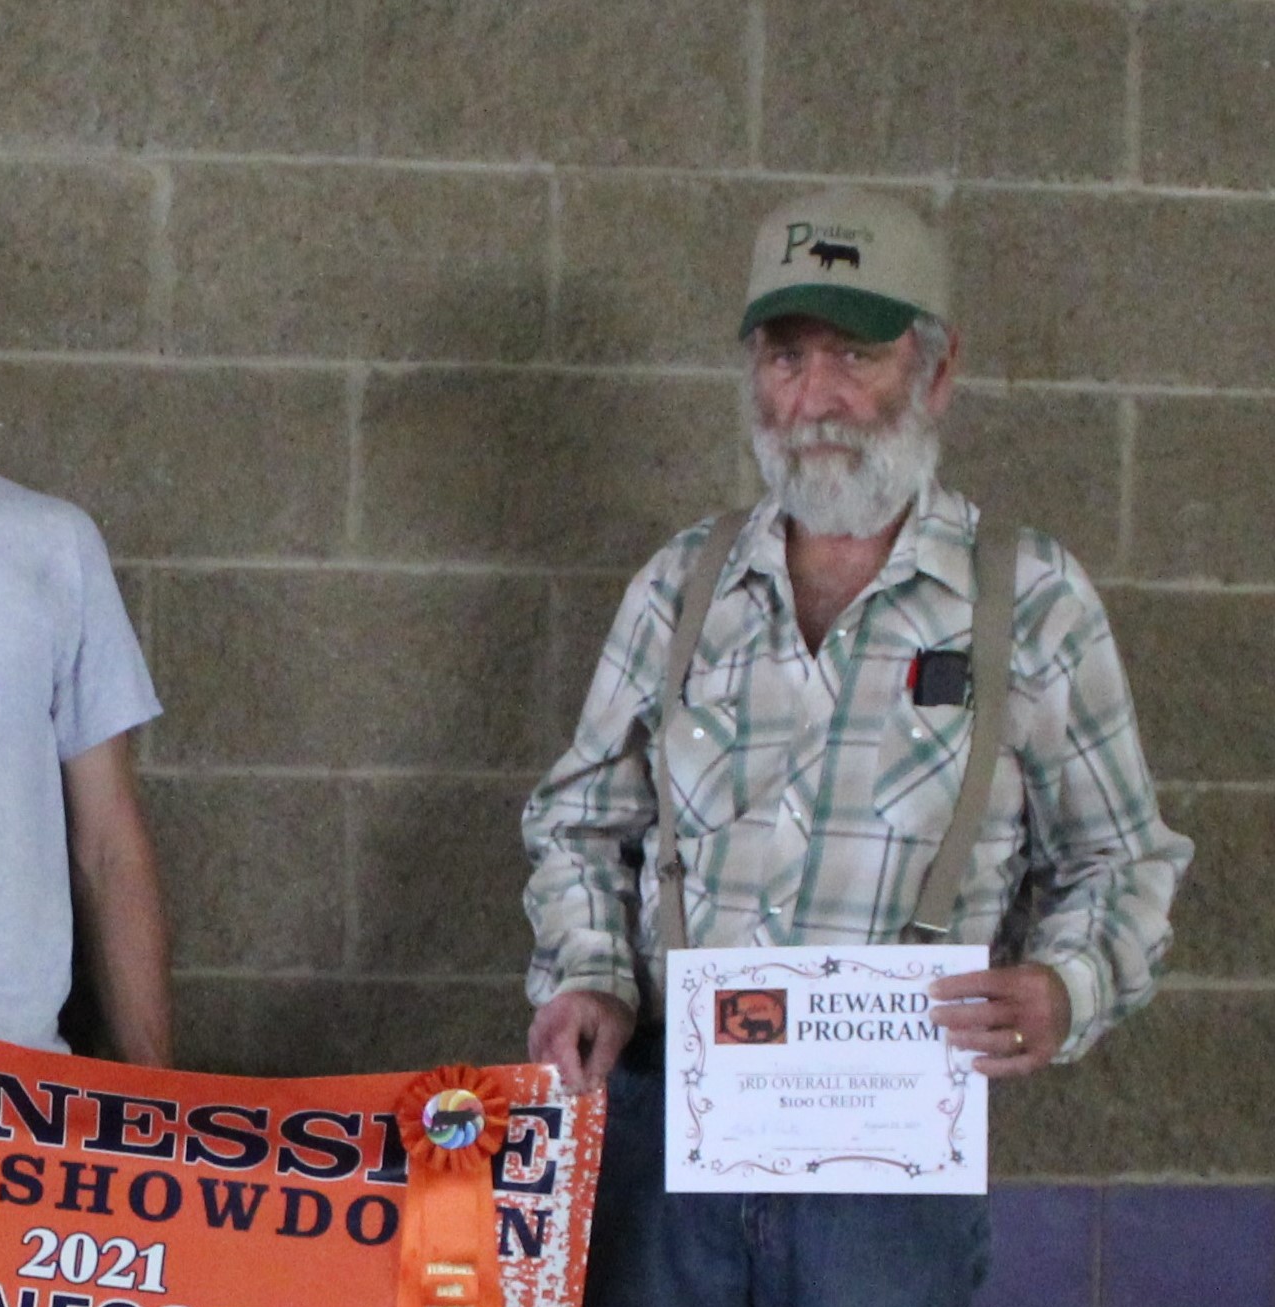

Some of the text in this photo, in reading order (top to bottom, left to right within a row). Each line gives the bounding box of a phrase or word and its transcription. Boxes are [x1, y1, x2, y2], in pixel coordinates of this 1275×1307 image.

[808, 992, 930, 1014] REWARD
[797, 1020, 941, 1042] PROGRAM
[739, 1076, 918, 1093] 3RD OVERALL BARROW
[779, 1095, 876, 1109] $100 CREDIT
[17, 1226, 167, 1294] 2021
